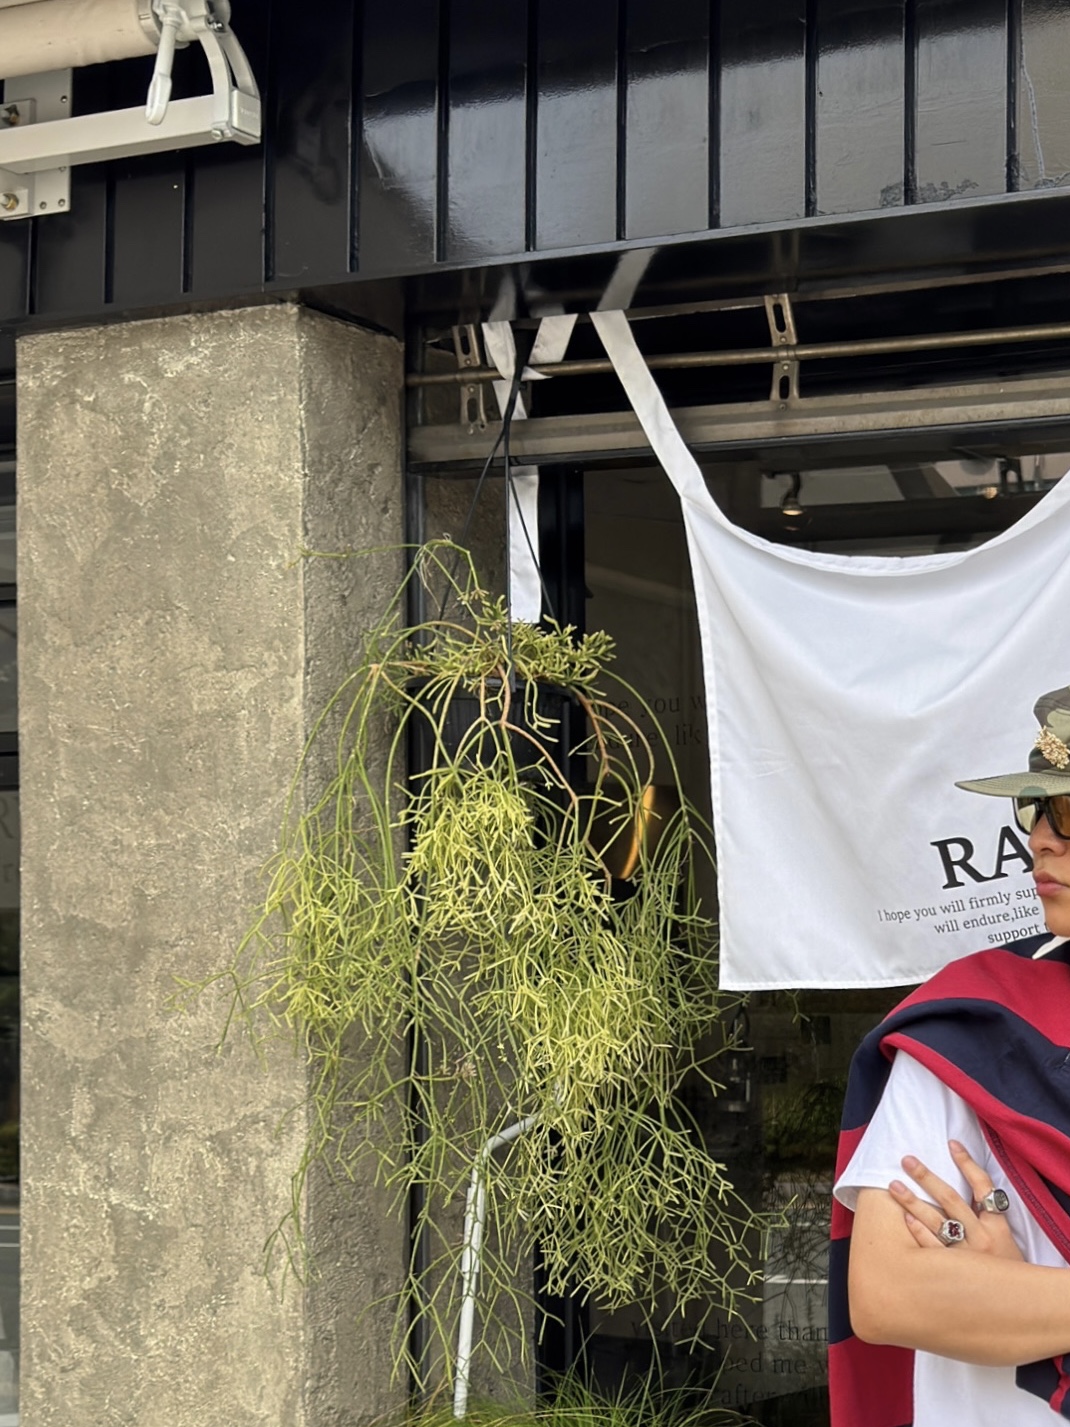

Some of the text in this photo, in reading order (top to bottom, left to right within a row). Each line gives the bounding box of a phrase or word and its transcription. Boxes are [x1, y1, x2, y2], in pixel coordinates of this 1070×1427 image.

[882, 908, 911, 923] hope
[914, 905, 937, 921] you
[940, 899, 966, 915] will
[968, 891, 1011, 910] firmly
[934, 919, 960, 934] will
[988, 923, 1041, 944] support
[714, 1317, 768, 1339] here
[773, 1358, 807, 1374] me
